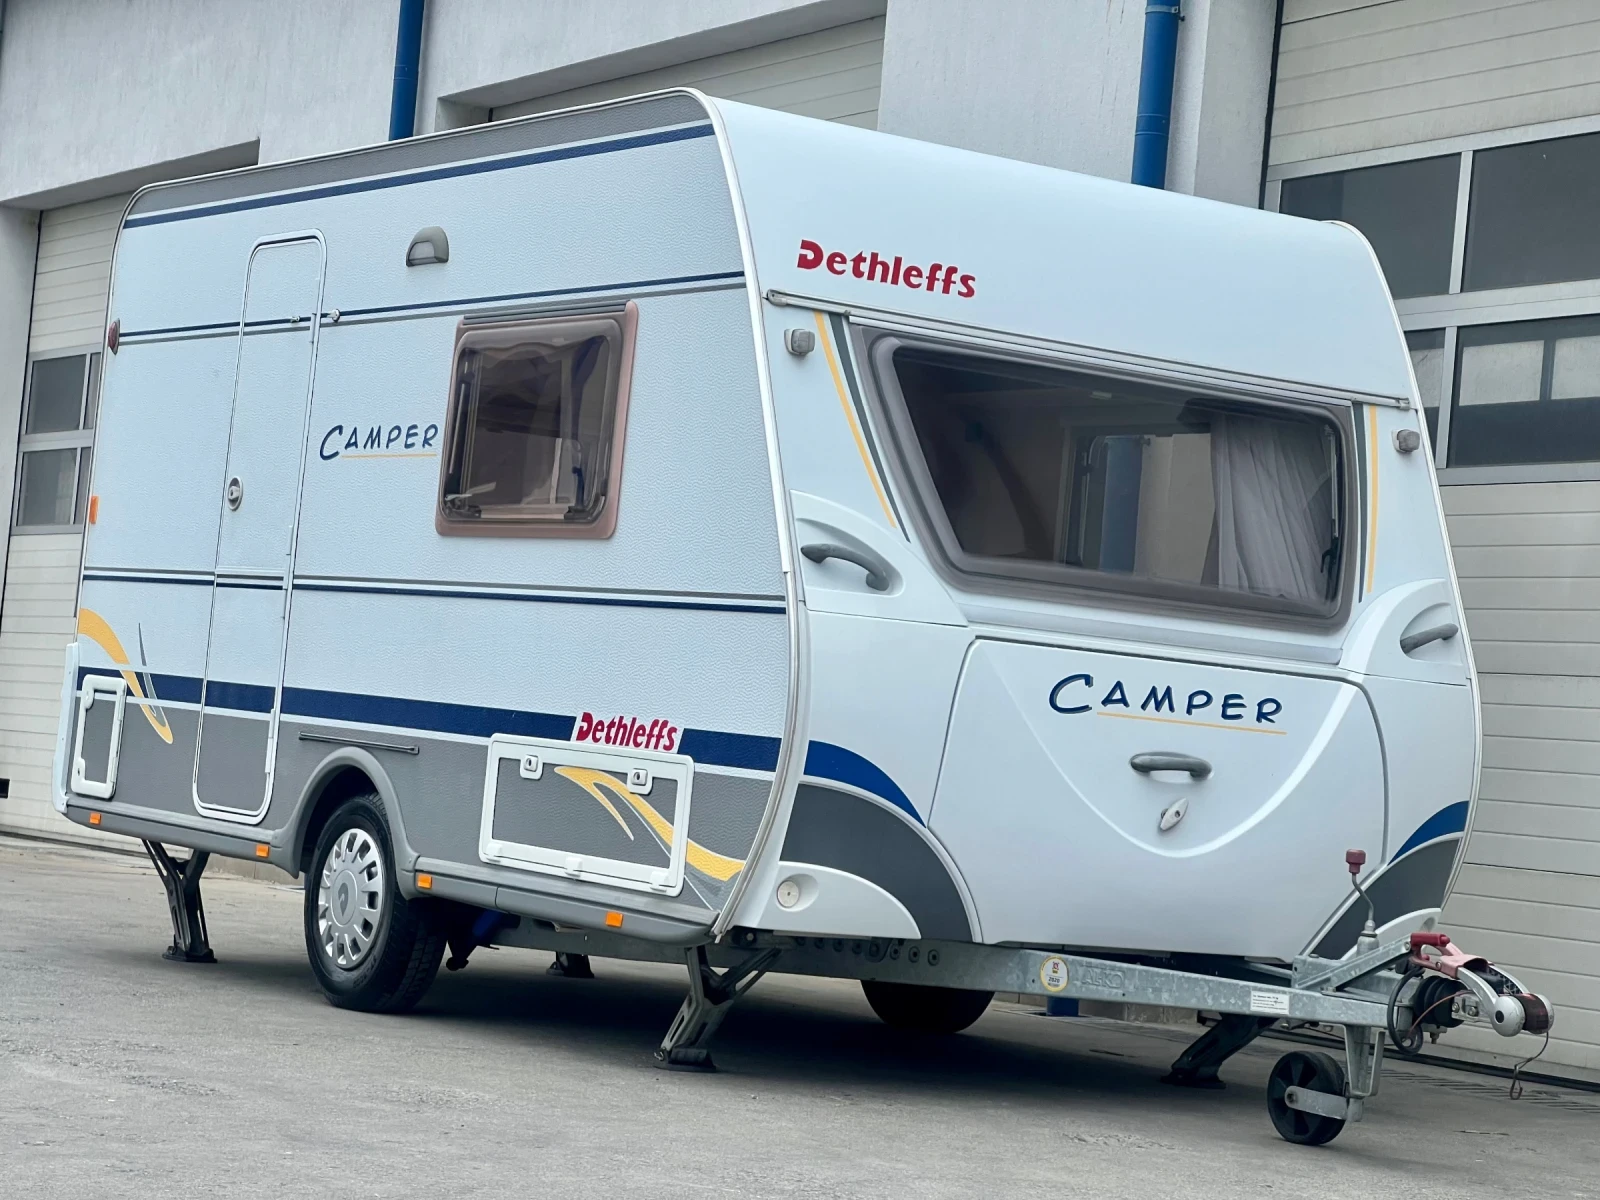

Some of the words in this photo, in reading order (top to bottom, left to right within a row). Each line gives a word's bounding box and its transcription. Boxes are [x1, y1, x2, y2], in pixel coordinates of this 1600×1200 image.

[797, 239, 976, 298] Dethleffs
[319, 424, 439, 461] CAMPER
[1049, 673, 1283, 724] CAMPER
[576, 711, 678, 752] Dethleffs
